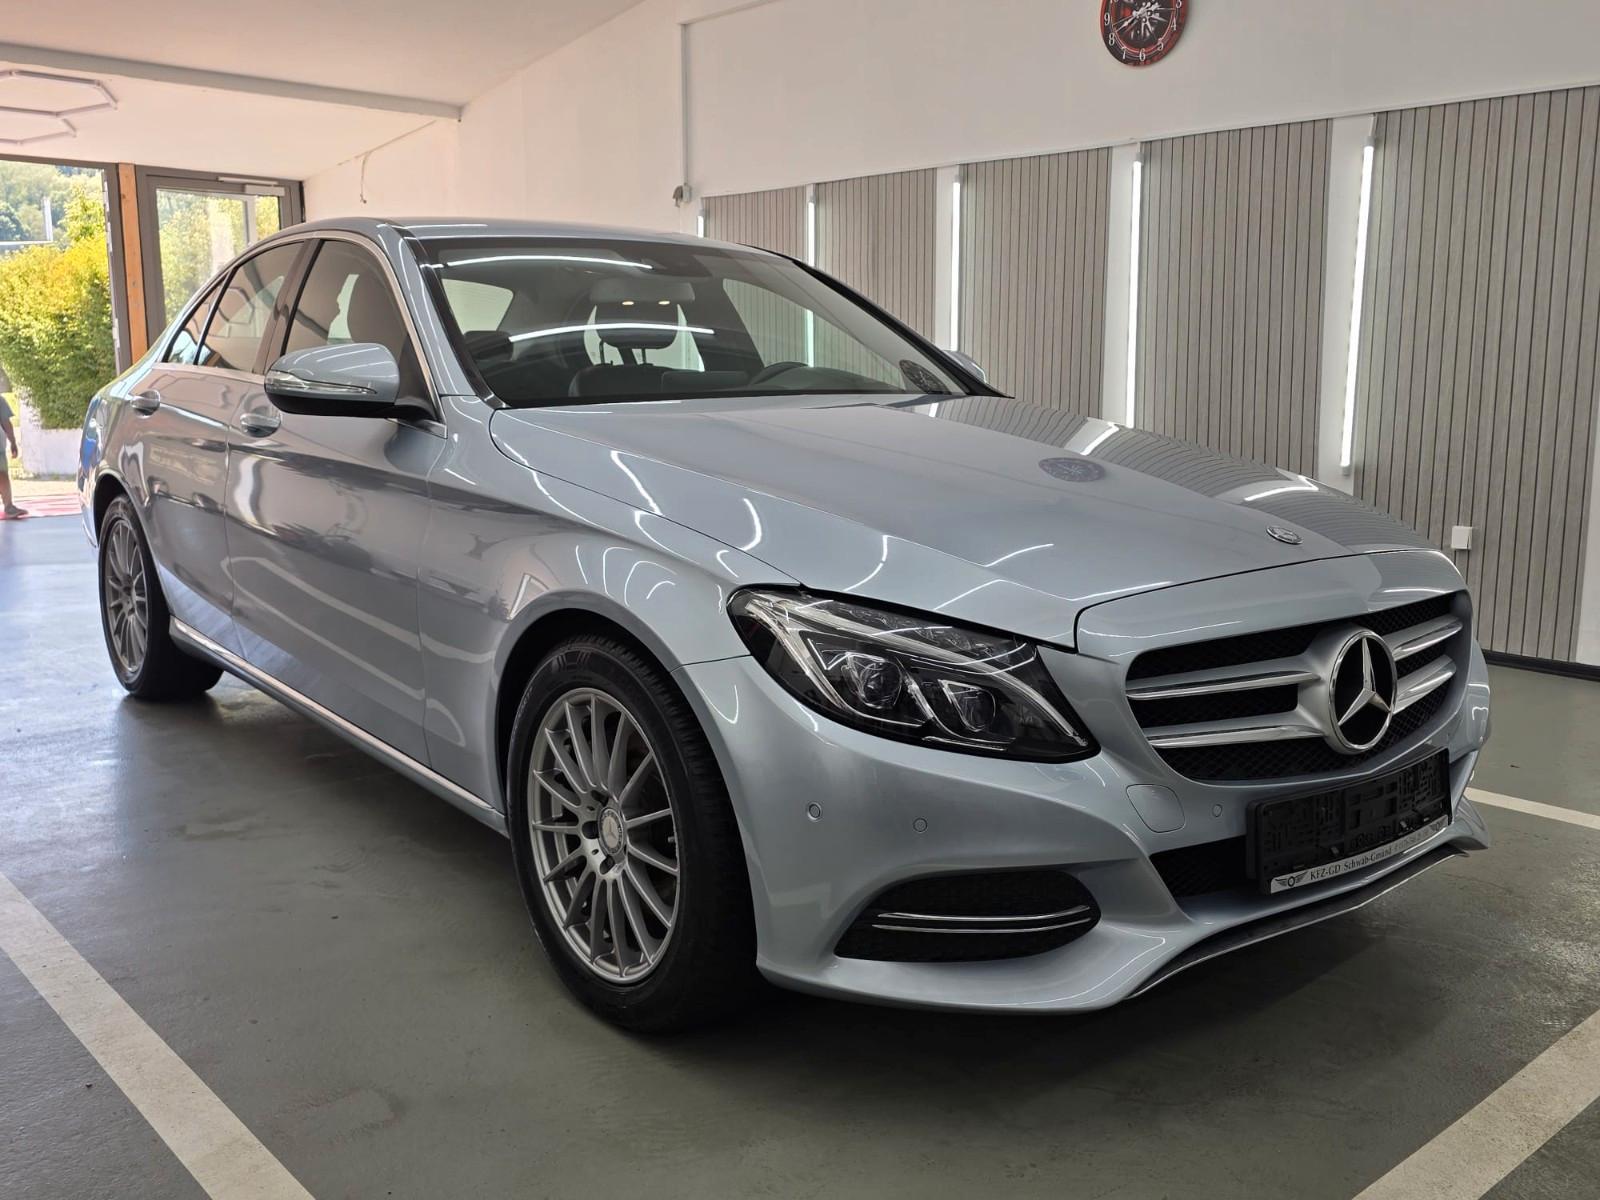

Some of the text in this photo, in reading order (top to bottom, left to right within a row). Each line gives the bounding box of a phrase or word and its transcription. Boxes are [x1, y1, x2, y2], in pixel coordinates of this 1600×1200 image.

[1104, 12, 1111, 26] 9
[1171, 17, 1177, 31] 4
[1108, 32, 1115, 46] 8
[1121, 46, 1127, 60] 7
[1139, 48, 1146, 62] 6
[1310, 864, 1342, 881] KFZ-GD
